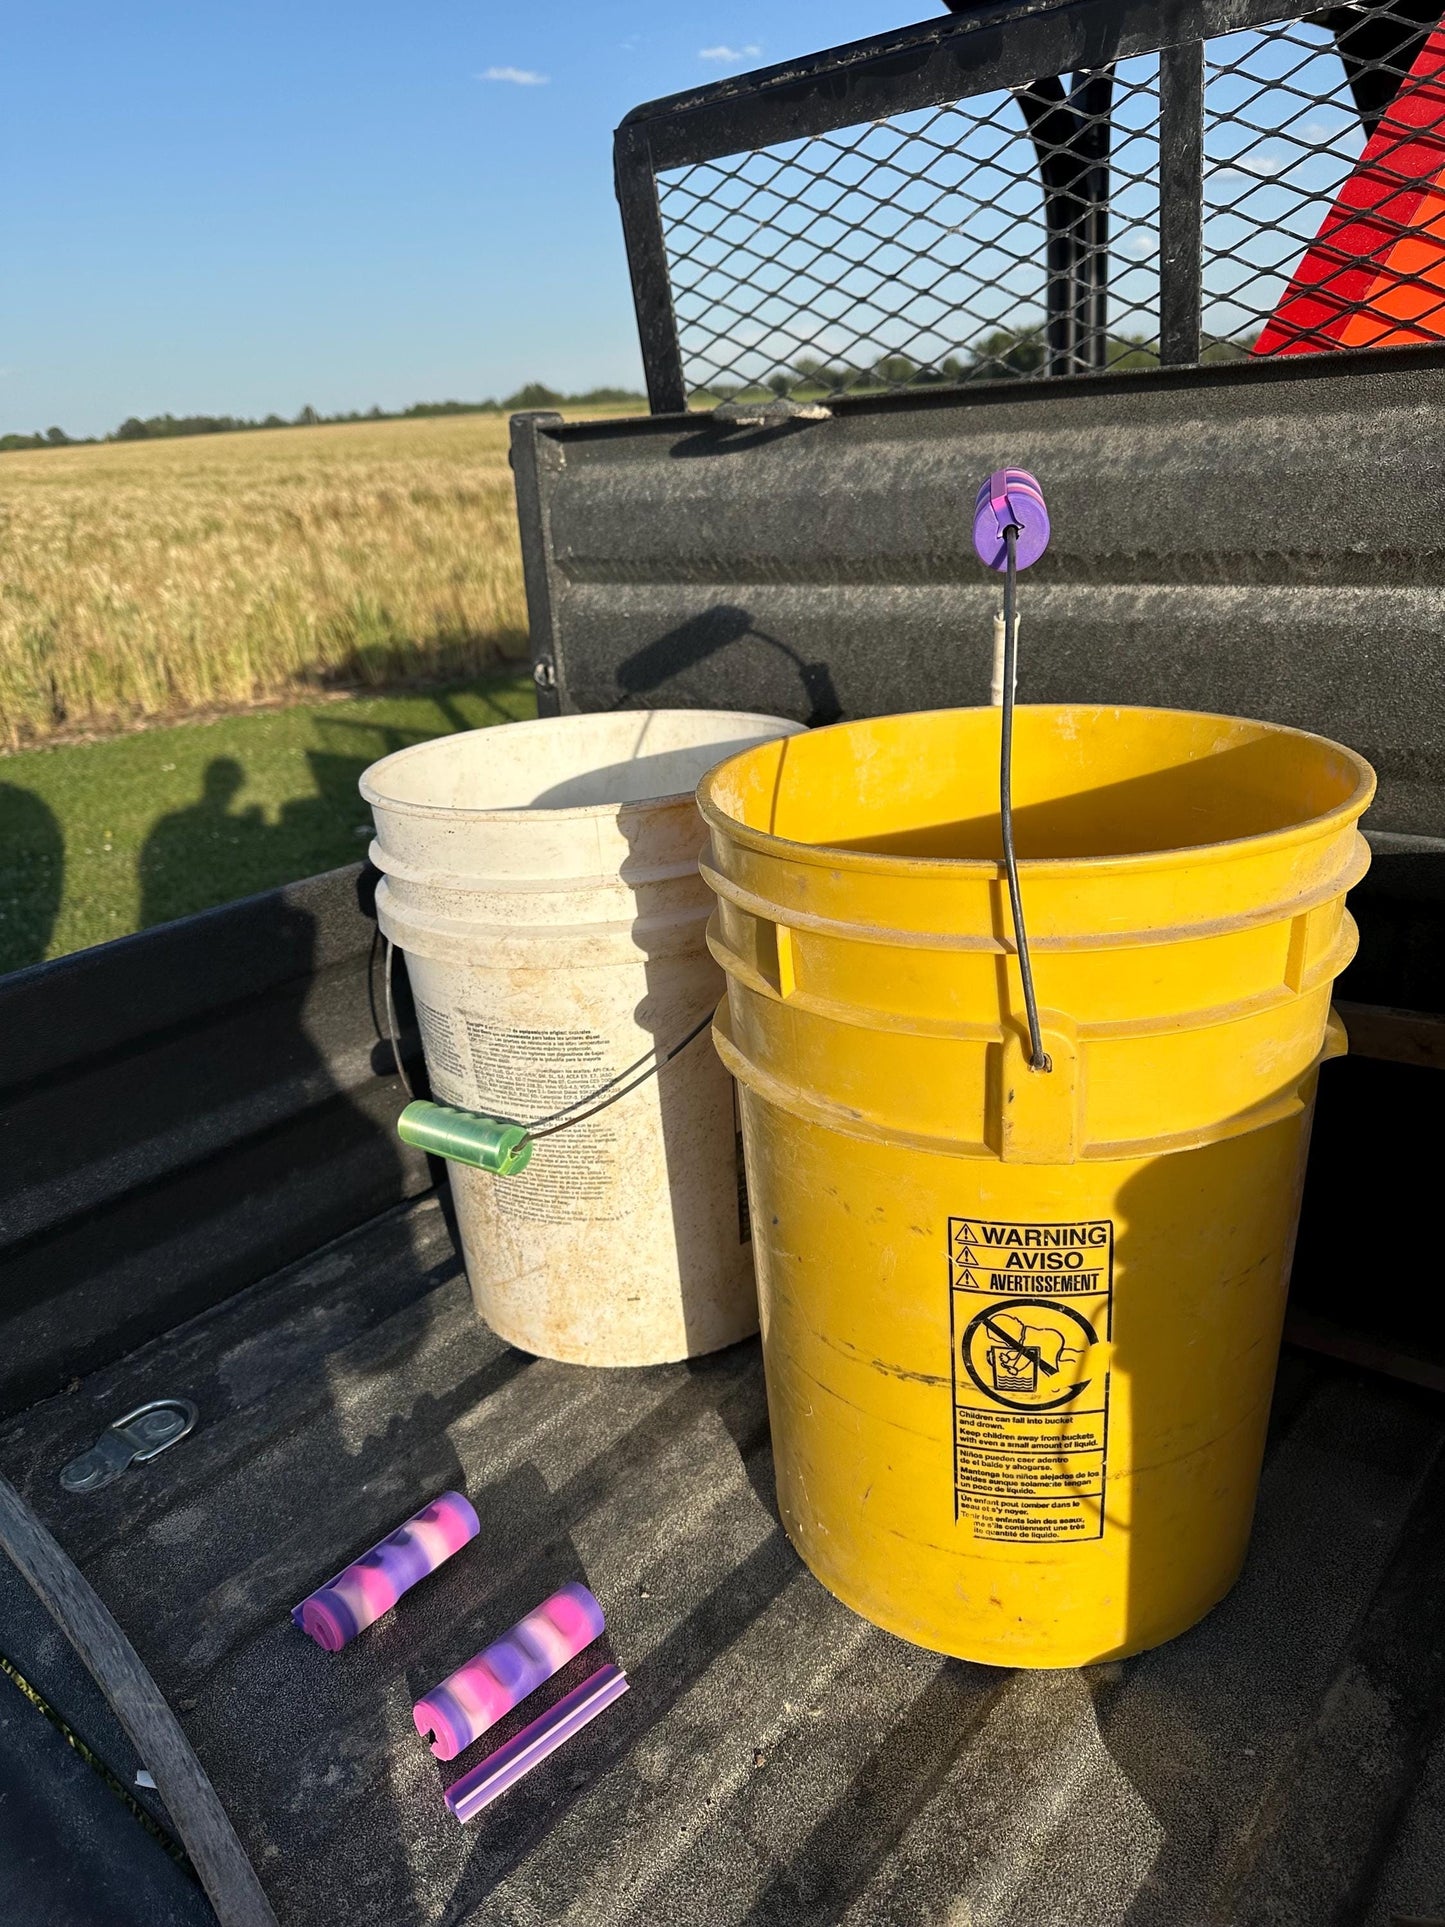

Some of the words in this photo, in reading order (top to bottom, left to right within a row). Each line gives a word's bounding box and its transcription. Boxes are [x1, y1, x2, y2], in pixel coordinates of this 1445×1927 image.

[981, 1226, 1107, 1246] WARNING
[1005, 1251, 1084, 1270] AVISO
[990, 1273, 1100, 1293] AVERTISSEMENT
[959, 1410, 993, 1421] Children
[1012, 1416, 1026, 1424] fall
[1045, 1416, 1074, 1424] bucket
[976, 1421, 1005, 1430] drown.
[959, 1427, 981, 1437] Keep
[983, 1432, 1015, 1441] children
[1061, 1432, 1095, 1441] buckets
[959, 1436, 977, 1444] with
[1074, 1439, 1098, 1448] liquid.
[960, 1449, 983, 1459] Niños
[985, 1454, 1016, 1462] pueden
[1037, 1456, 1069, 1464] adentro
[981, 1460, 1004, 1469] balde
[960, 1466, 1000, 1478] Mantenga
[1040, 1473, 1074, 1481] alejados
[1075, 1471, 1086, 1479] de
[1087, 1470, 1100, 1478] los
[960, 1473, 987, 1483] baldes
[988, 1479, 1019, 1487] aunque
[1064, 1479, 1092, 1487] tengan
[972, 1483, 993, 1491] poco
[960, 1502, 980, 1510] seau
[995, 1516, 1025, 1524] enfants
[1004, 1524, 1052, 1532] contiennent
[1031, 1532, 1060, 1540] liquide.
